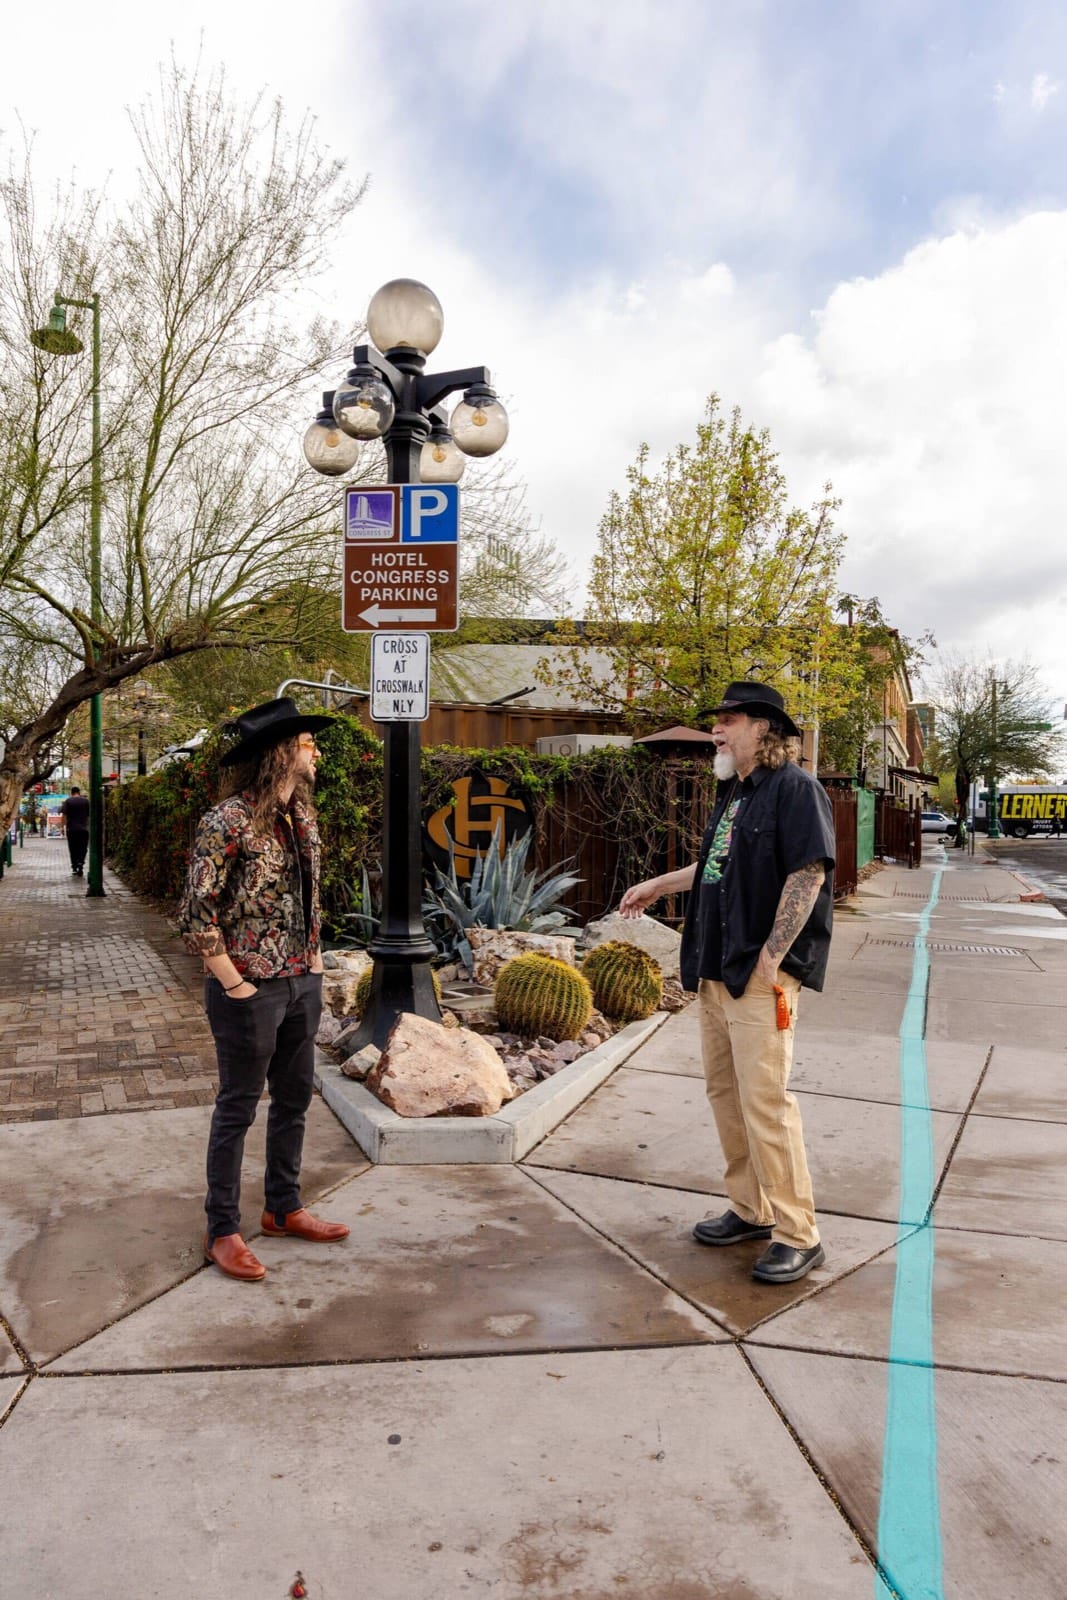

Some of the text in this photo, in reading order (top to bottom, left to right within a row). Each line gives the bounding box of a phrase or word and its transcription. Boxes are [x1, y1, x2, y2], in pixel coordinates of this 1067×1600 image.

[410, 489, 448, 537] P
[371, 552, 428, 567] HOTEL
[350, 570, 449, 584] CONGRESS
[360, 587, 438, 602] PARKING
[383, 640, 418, 654] CROSS
[393, 660, 406, 673] AT
[376, 680, 424, 693] CROSSWALK
